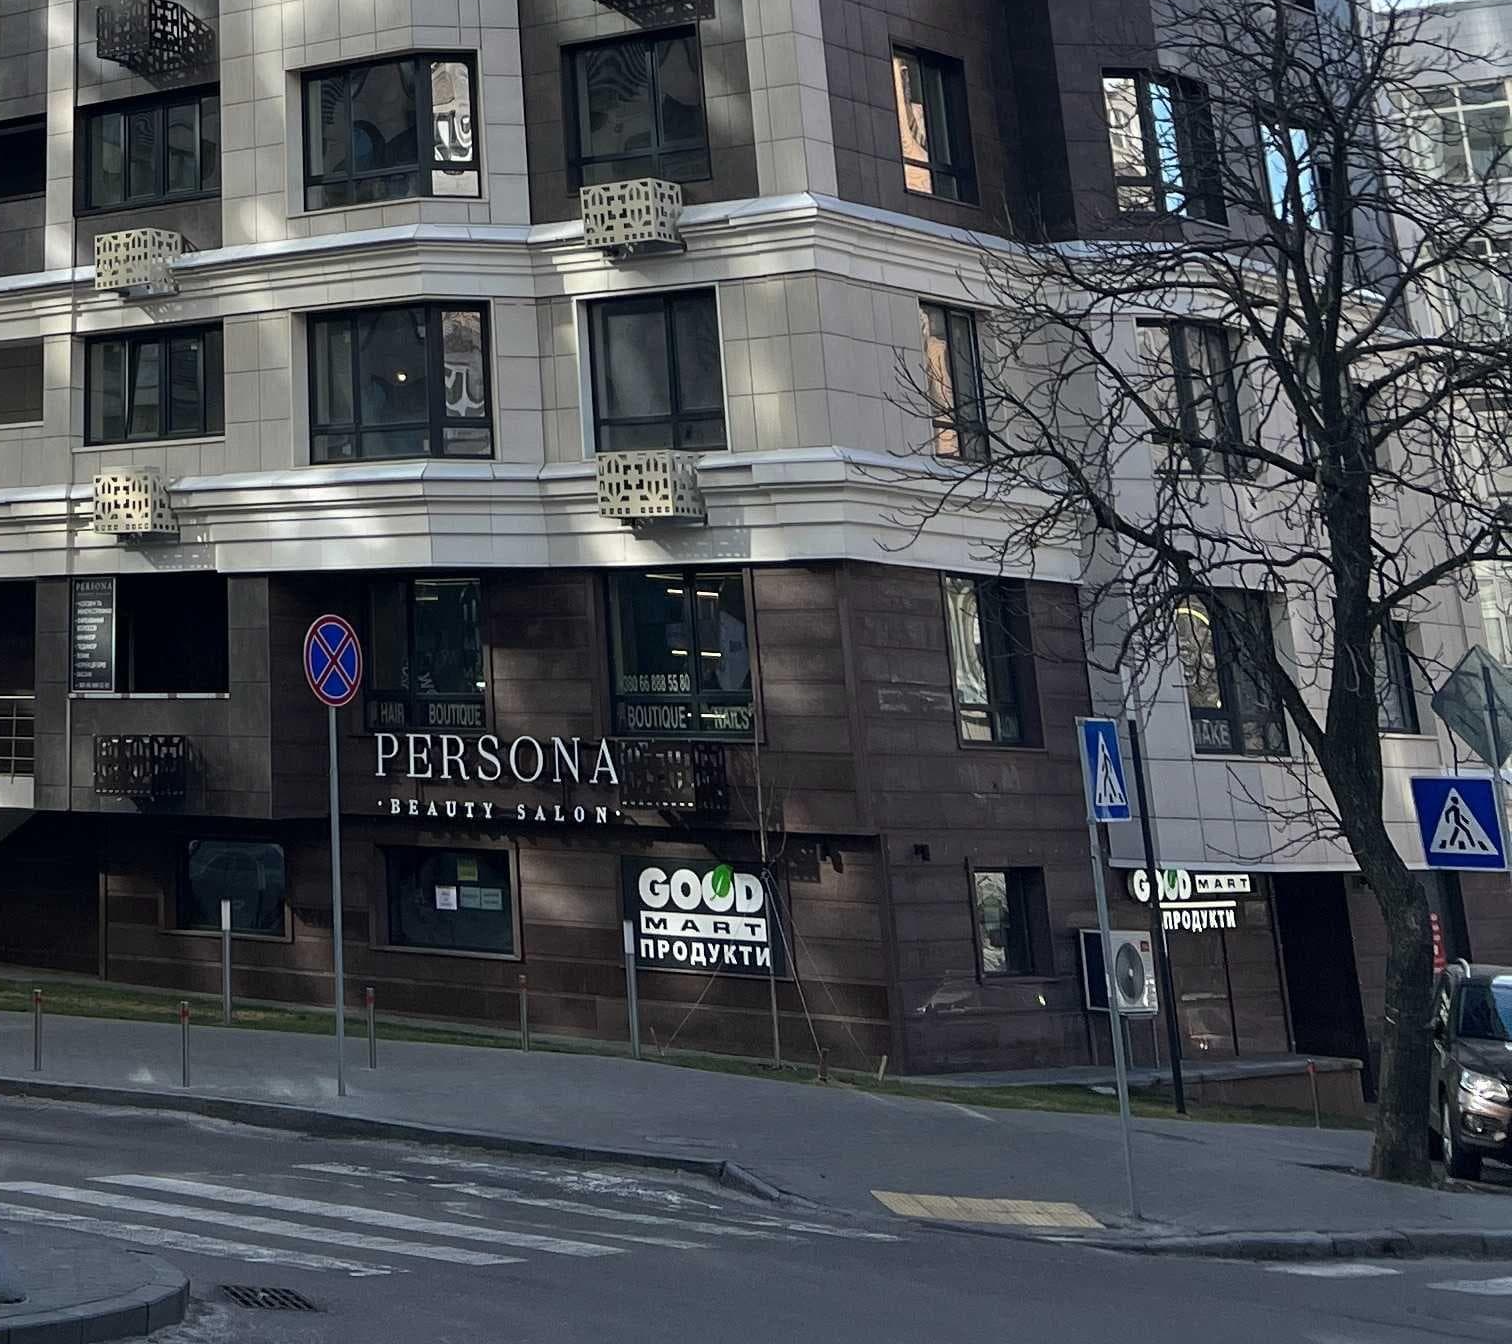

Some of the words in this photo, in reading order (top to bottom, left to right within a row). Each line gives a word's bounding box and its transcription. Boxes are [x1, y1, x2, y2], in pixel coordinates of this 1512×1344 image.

[380, 703, 404, 724] HAIR
[429, 703, 481, 725] BOUTIQUE
[627, 705, 687, 728] BOUTIQUE
[374, 733, 619, 785] PERSONA
[390, 798, 493, 819] BEAUTY
[517, 803, 607, 824] SALON
[639, 866, 764, 913] GOOD
[1198, 878, 1248, 889] MART
[645, 916, 761, 936] MART
[1162, 909, 1236, 933] ПРОДУКТИ
[640, 938, 770, 967] ПРОДУКТИ
